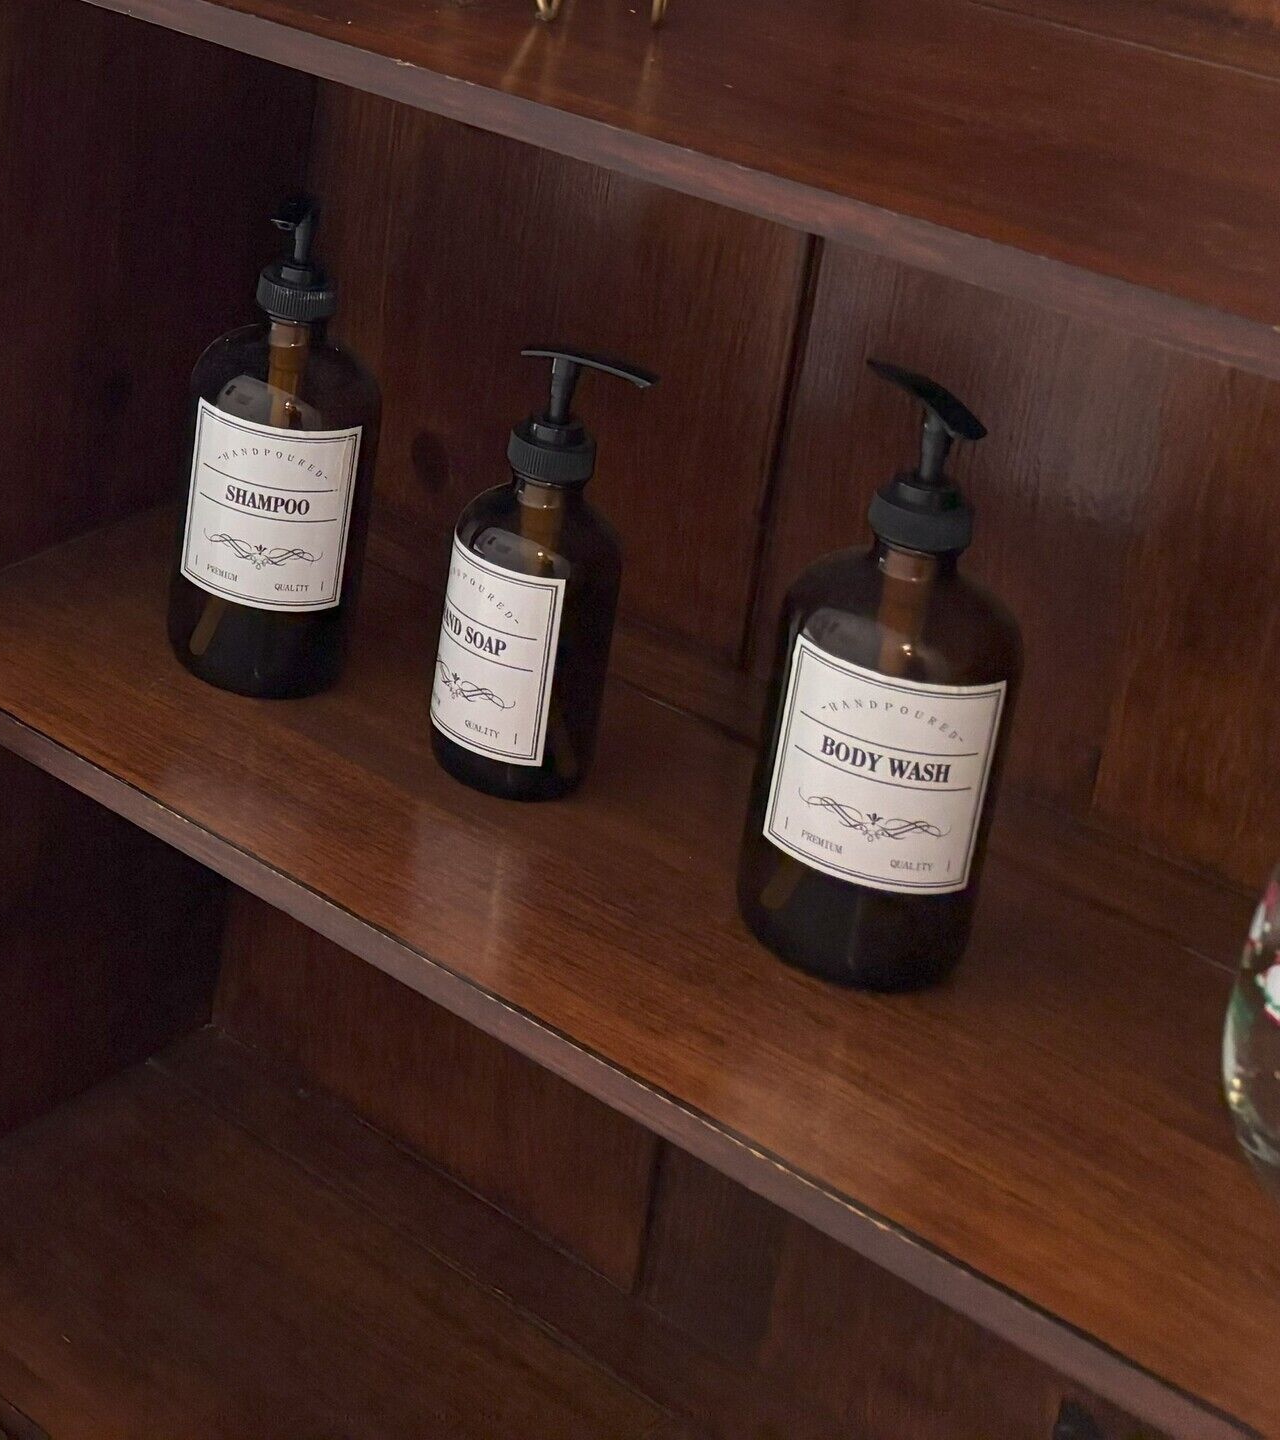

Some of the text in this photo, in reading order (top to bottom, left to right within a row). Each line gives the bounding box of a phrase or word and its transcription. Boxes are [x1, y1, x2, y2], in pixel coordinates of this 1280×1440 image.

[225, 484, 310, 515] SHAMPOO
[207, 563, 310, 592] PREMIUM QUALITY
[464, 625, 507, 657] SOAP
[465, 720, 500, 738] QUALITY
[821, 734, 951, 783] BODY WASH
[801, 829, 934, 871] PREMIUM QUALITY
